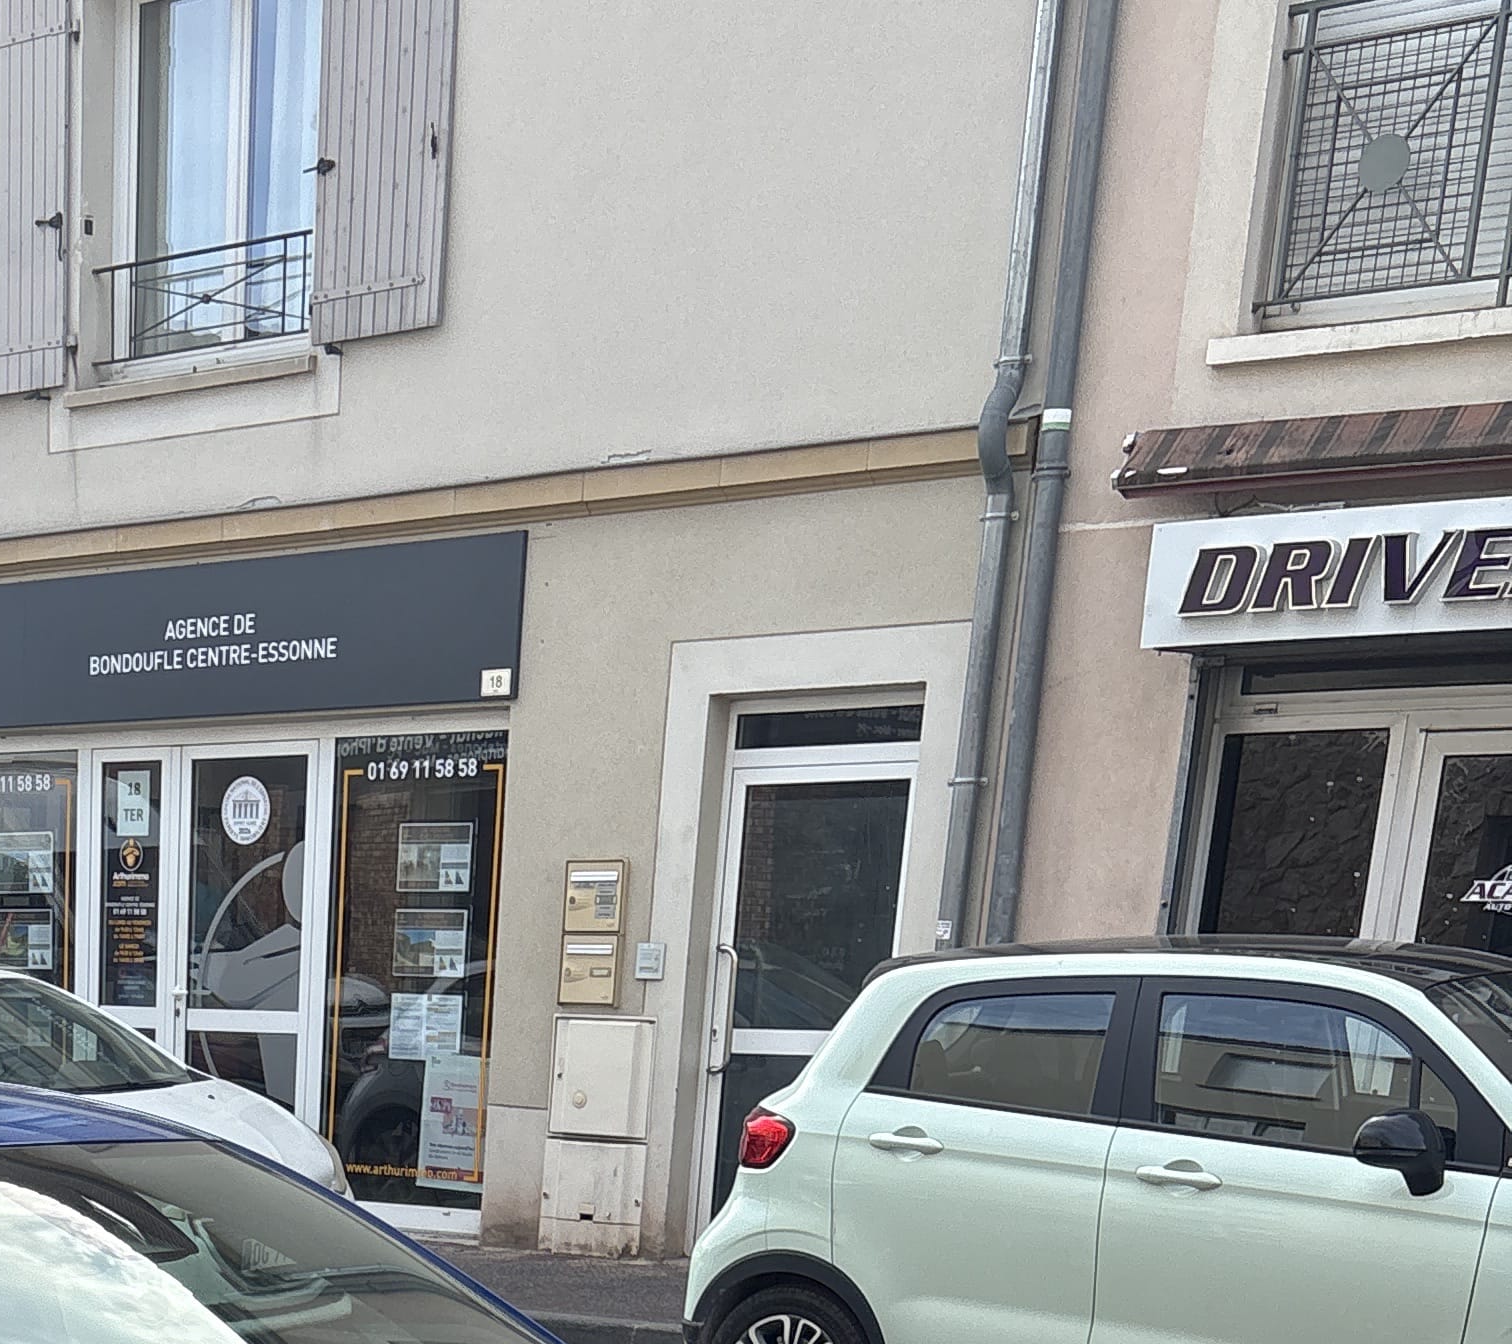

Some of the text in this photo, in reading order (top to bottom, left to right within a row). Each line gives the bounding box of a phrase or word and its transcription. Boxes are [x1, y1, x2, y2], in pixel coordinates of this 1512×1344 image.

[1177, 528, 1512, 619] DRIVE
[164, 613, 256, 640] AGENCE DE
[89, 637, 338, 676] BONDOUFLE CENTRE-ESSONNE
[489, 675, 503, 689] 18
[367, 758, 477, 780] 01 69 11 58 58
[0, 776, 14, 792] 11
[17, 775, 32, 791] 58
[35, 774, 51, 791] 58
[128, 782, 141, 796] 18
[123, 808, 144, 822] TER
